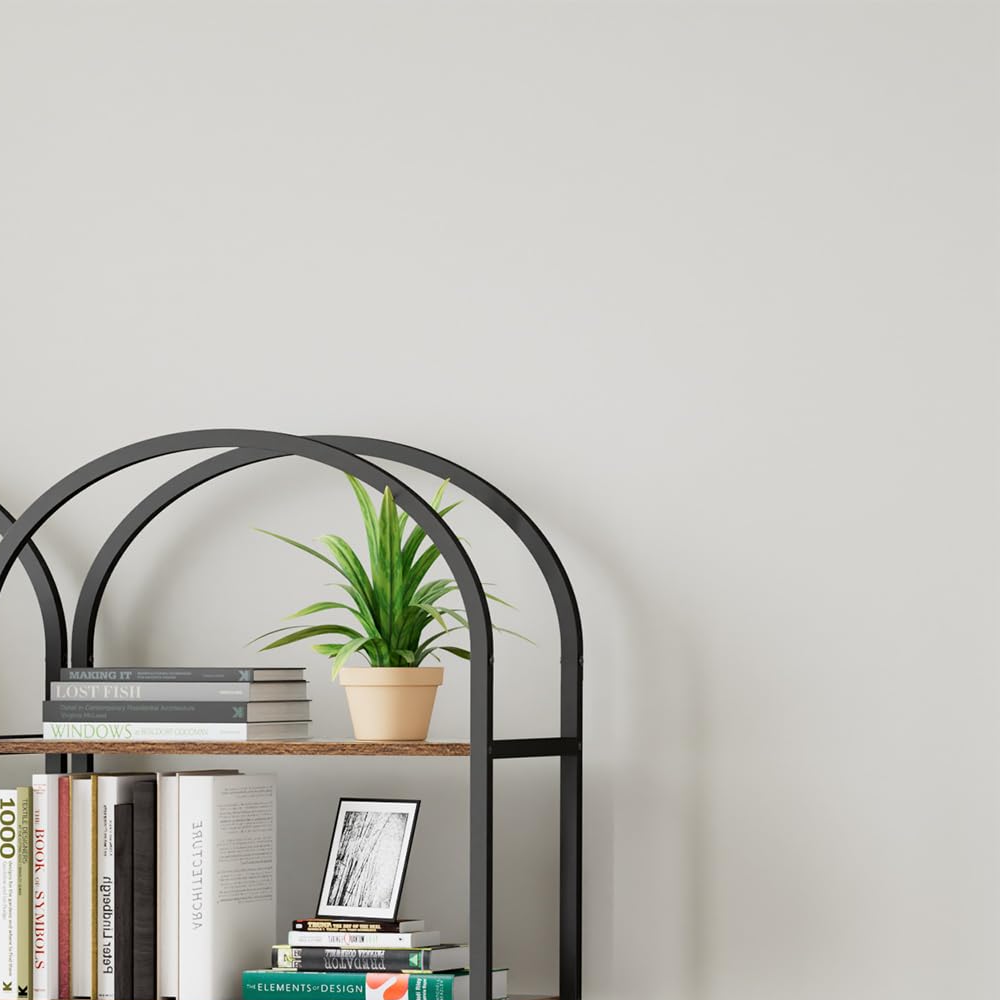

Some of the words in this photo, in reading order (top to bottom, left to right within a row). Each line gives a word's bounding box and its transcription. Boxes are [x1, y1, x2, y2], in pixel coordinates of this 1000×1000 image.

[69, 671, 117, 680] MAKING
[119, 671, 133, 680] IT
[55, 685, 101, 699] LOST
[104, 686, 142, 699] FISH
[51, 723, 133, 739] WINDOWS
[0, 797, 16, 859] 1000
[34, 828, 45, 873] BOOK
[34, 891, 45, 970] SYMBOLS
[324, 958, 386, 970] PREDATOR
[18, 985, 28, 997] K
[257, 982, 312, 993] ELEMENTS
[320, 982, 363, 994] DESIGN
